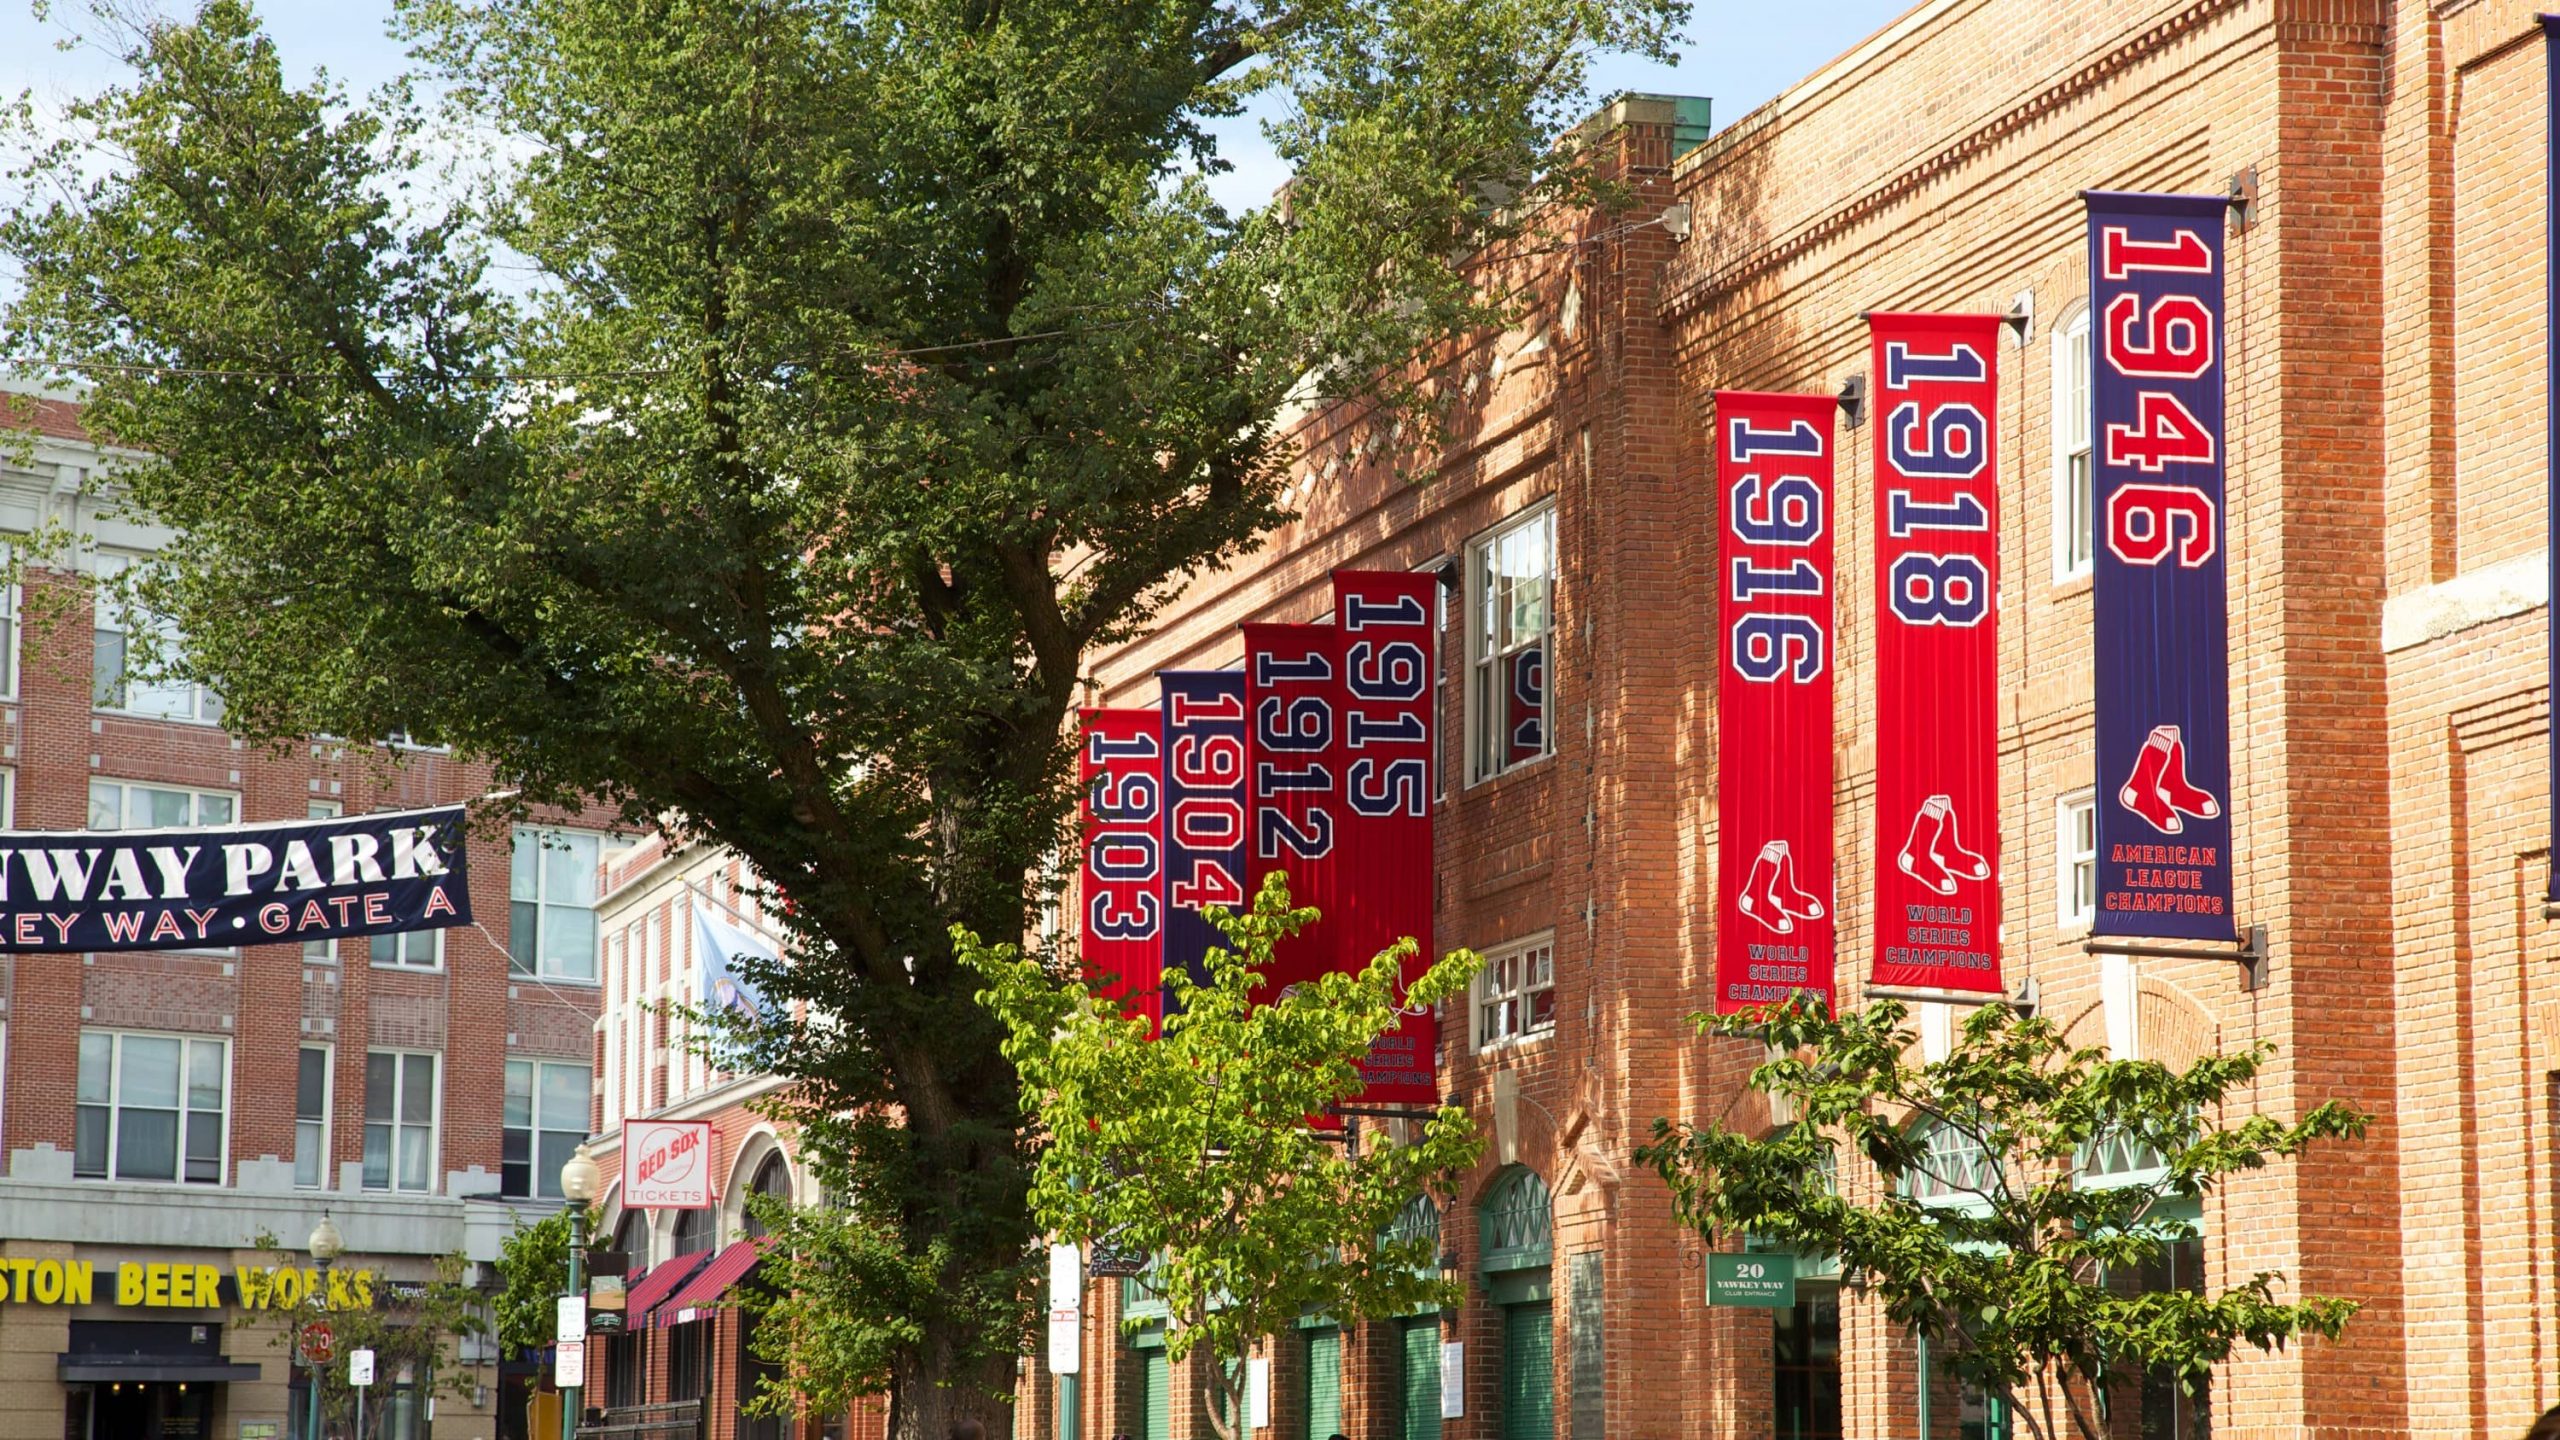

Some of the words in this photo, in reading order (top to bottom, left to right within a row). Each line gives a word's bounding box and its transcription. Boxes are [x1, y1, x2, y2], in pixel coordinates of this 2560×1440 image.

[2101, 226, 2216, 568] 1946
[1886, 341, 1989, 628] 1918
[1729, 417, 1825, 685] 1916
[1345, 593, 1426, 818] 1915
[1256, 651, 1334, 860] 1912
[1171, 691, 1245, 912] 1904
[1089, 731, 1160, 942] 1903
[0, 846, 201, 901] WAY
[221, 825, 450, 896] PARK
[2111, 844, 2217, 866] AMERICAN
[2126, 868, 2203, 889] LEAGUE
[0, 912, 80, 945] EY
[102, 907, 219, 943] WAY
[259, 893, 393, 935] GATE
[423, 885, 457, 919] A
[1906, 904, 1973, 925] WORLD
[2105, 892, 2224, 915] CHAMPIONS
[1908, 926, 1971, 946] SERIES
[1748, 944, 1809, 963] WORLD
[1886, 946, 1992, 970] CHAMPIONS
[1749, 964, 1808, 983] SERIES
[1364, 1053, 1415, 1068] SERIES
[636, 1146, 666, 1186] RED
[670, 1127, 700, 1161] SOX
[630, 1190, 702, 1202] TICKETS
[1736, 1263, 1765, 1279] 20
[117, 1261, 221, 1308] BEER
[1717, 1280, 1760, 1290] YAWKEY
[1762, 1281, 1785, 1290] WAY
